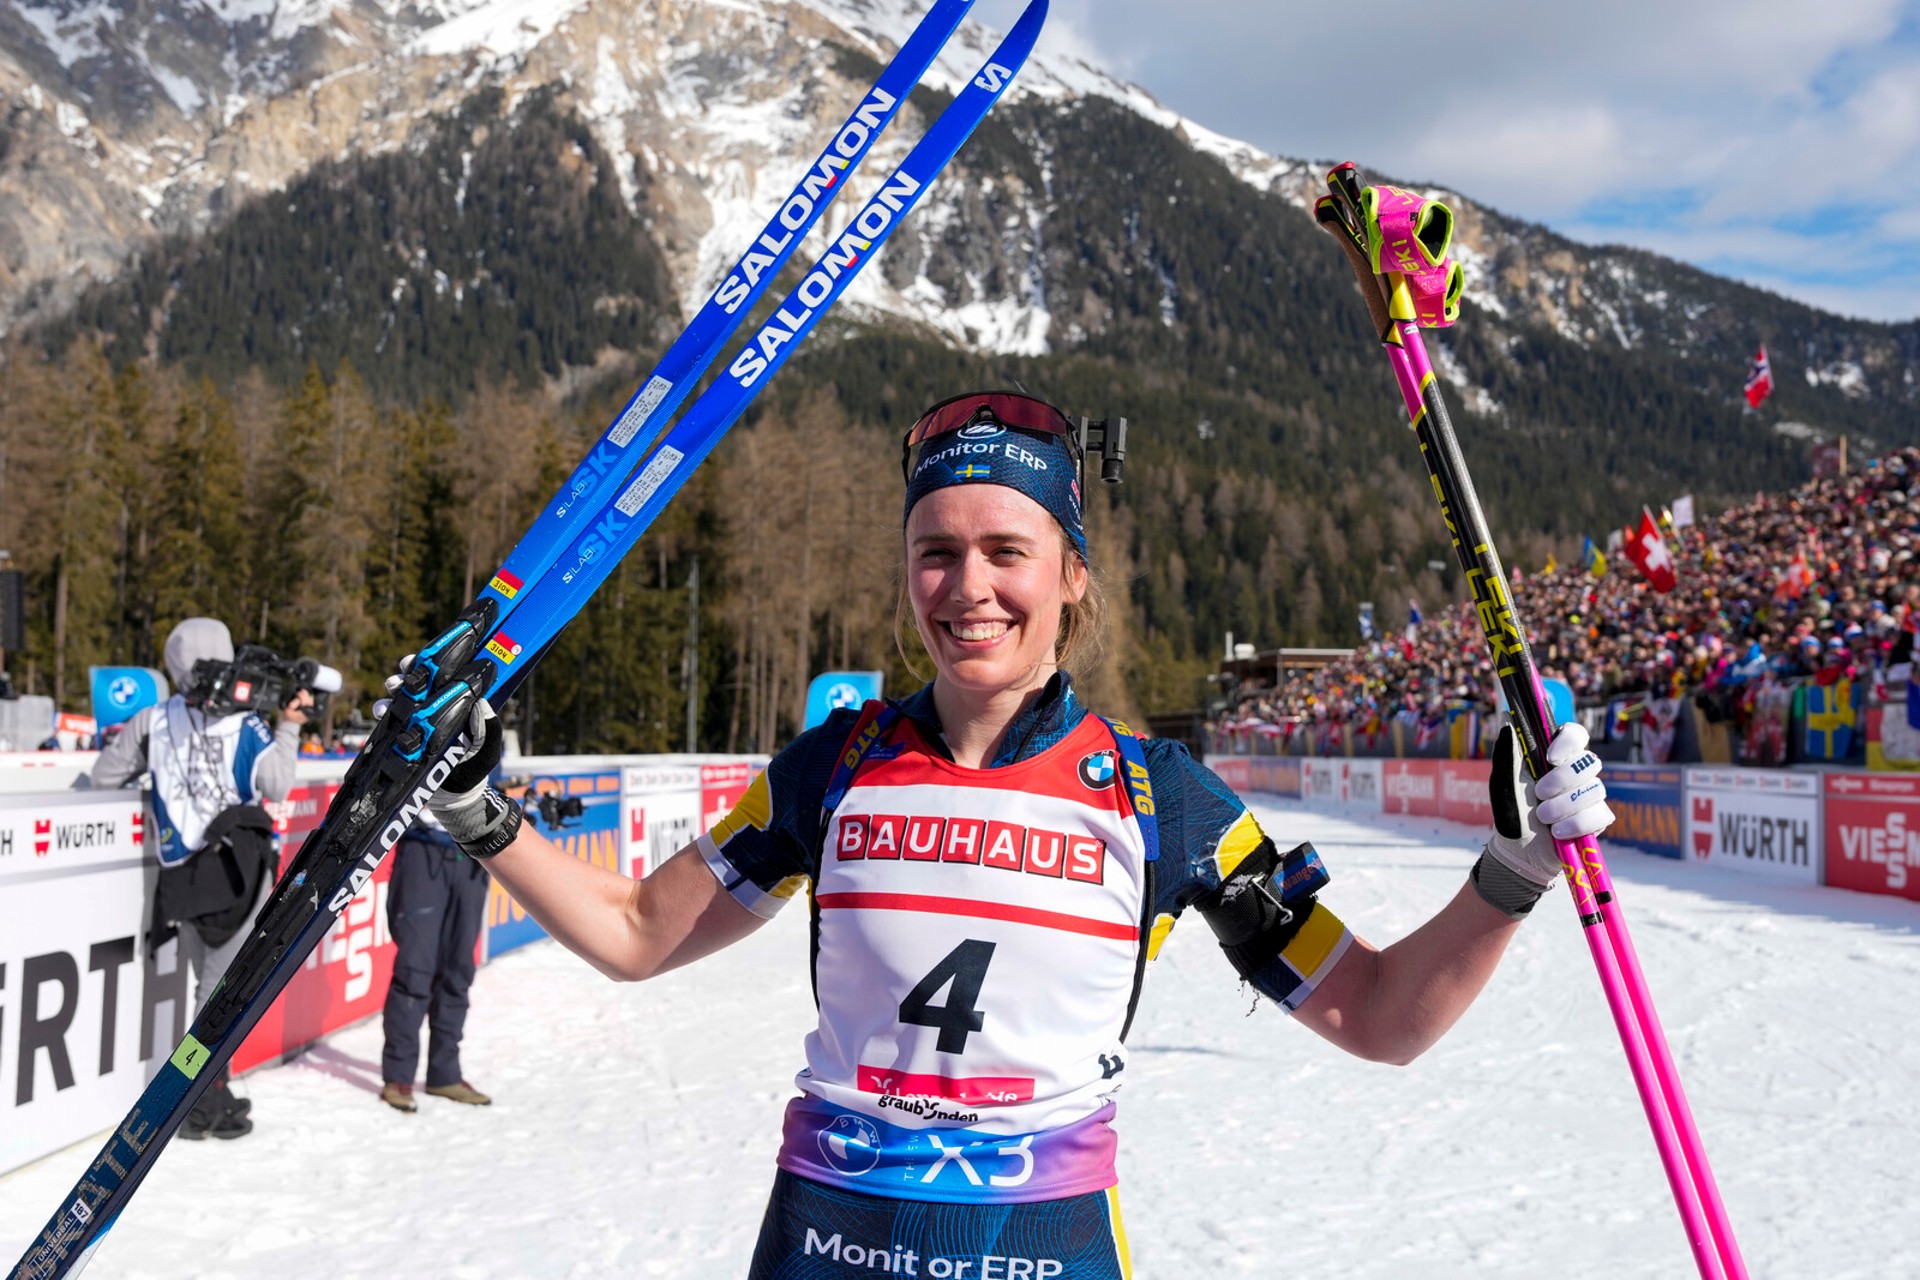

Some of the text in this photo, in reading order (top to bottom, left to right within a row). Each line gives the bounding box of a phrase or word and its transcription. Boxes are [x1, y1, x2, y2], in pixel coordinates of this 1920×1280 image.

[715, 87, 897, 315] SALOMON
[729, 169, 921, 388] SALOMON
[914, 441, 1049, 478] Monitor ERP
[1465, 567, 1518, 678] LEKI
[844, 718, 880, 769] ATG
[1126, 759, 1155, 817] ATG
[327, 731, 473, 918] SALOMON
[840, 817, 1100, 877] BAUHAUS
[0, 933, 188, 1108] RTH
[899, 938, 997, 1055] 4
[185, 1048, 198, 1066] 4
[919, 1134, 1034, 1188] X3
[74, 1202, 89, 1219] 187
[980, 1254, 1064, 1280] ERP
